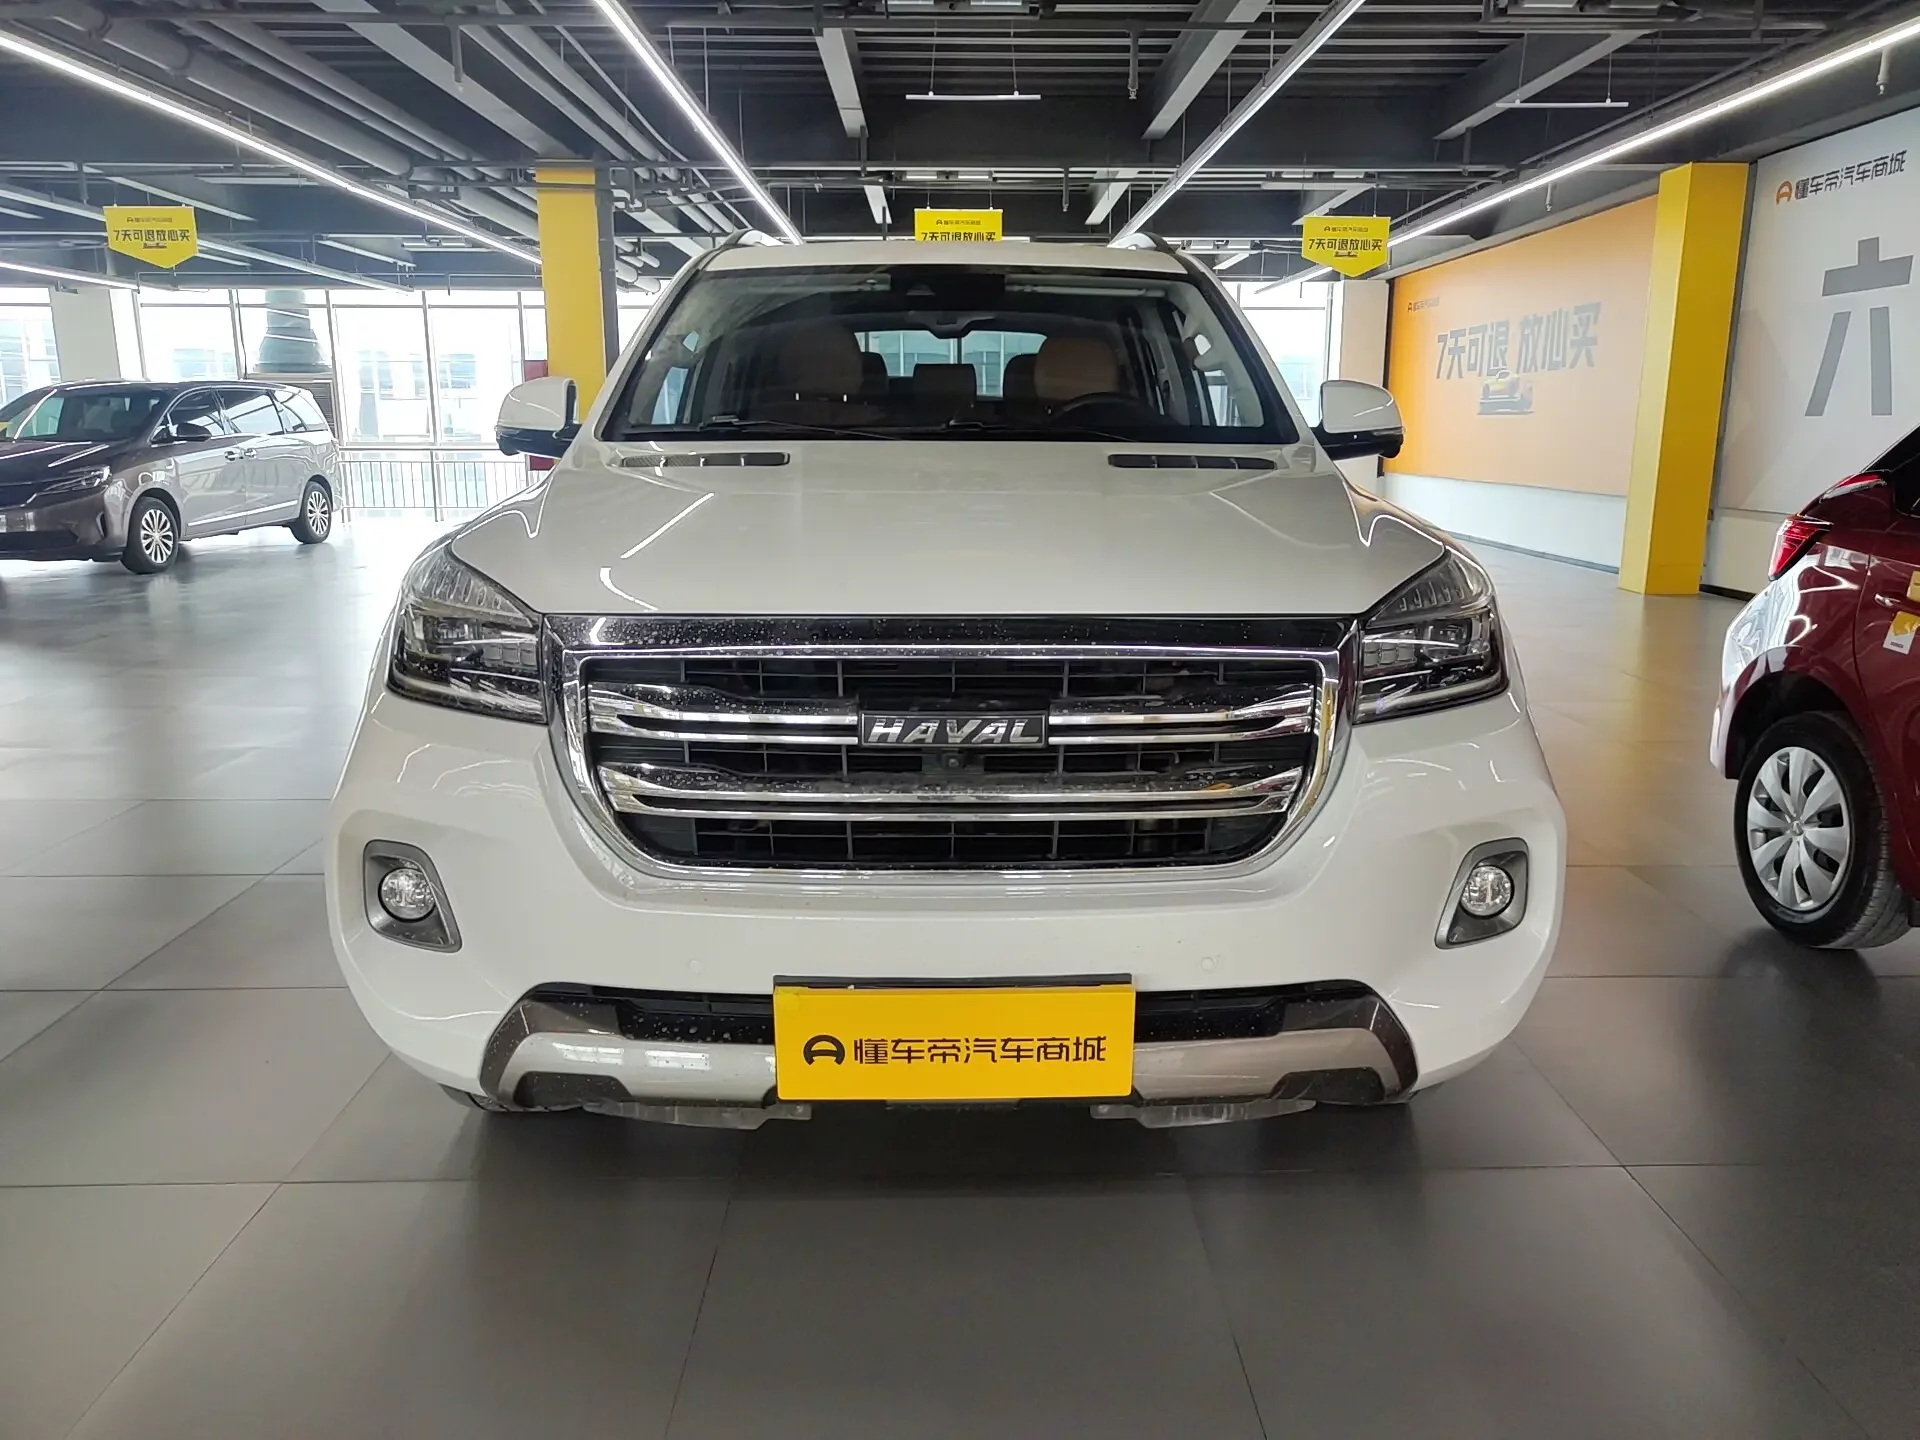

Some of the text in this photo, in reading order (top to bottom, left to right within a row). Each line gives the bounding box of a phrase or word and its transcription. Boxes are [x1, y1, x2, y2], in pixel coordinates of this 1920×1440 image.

[1794, 150, 1908, 201] 懂车帝汽车商城
[113, 229, 191, 242] 7天可退放心买
[1308, 238, 1383, 252] 7天可退放心买
[1436, 301, 1602, 380] 7天可退 放心买
[1804, 236, 1914, 417] 六
[867, 718, 1040, 744] HAVAL
[853, 1035, 1108, 1065] 懂车帝汽车商城
